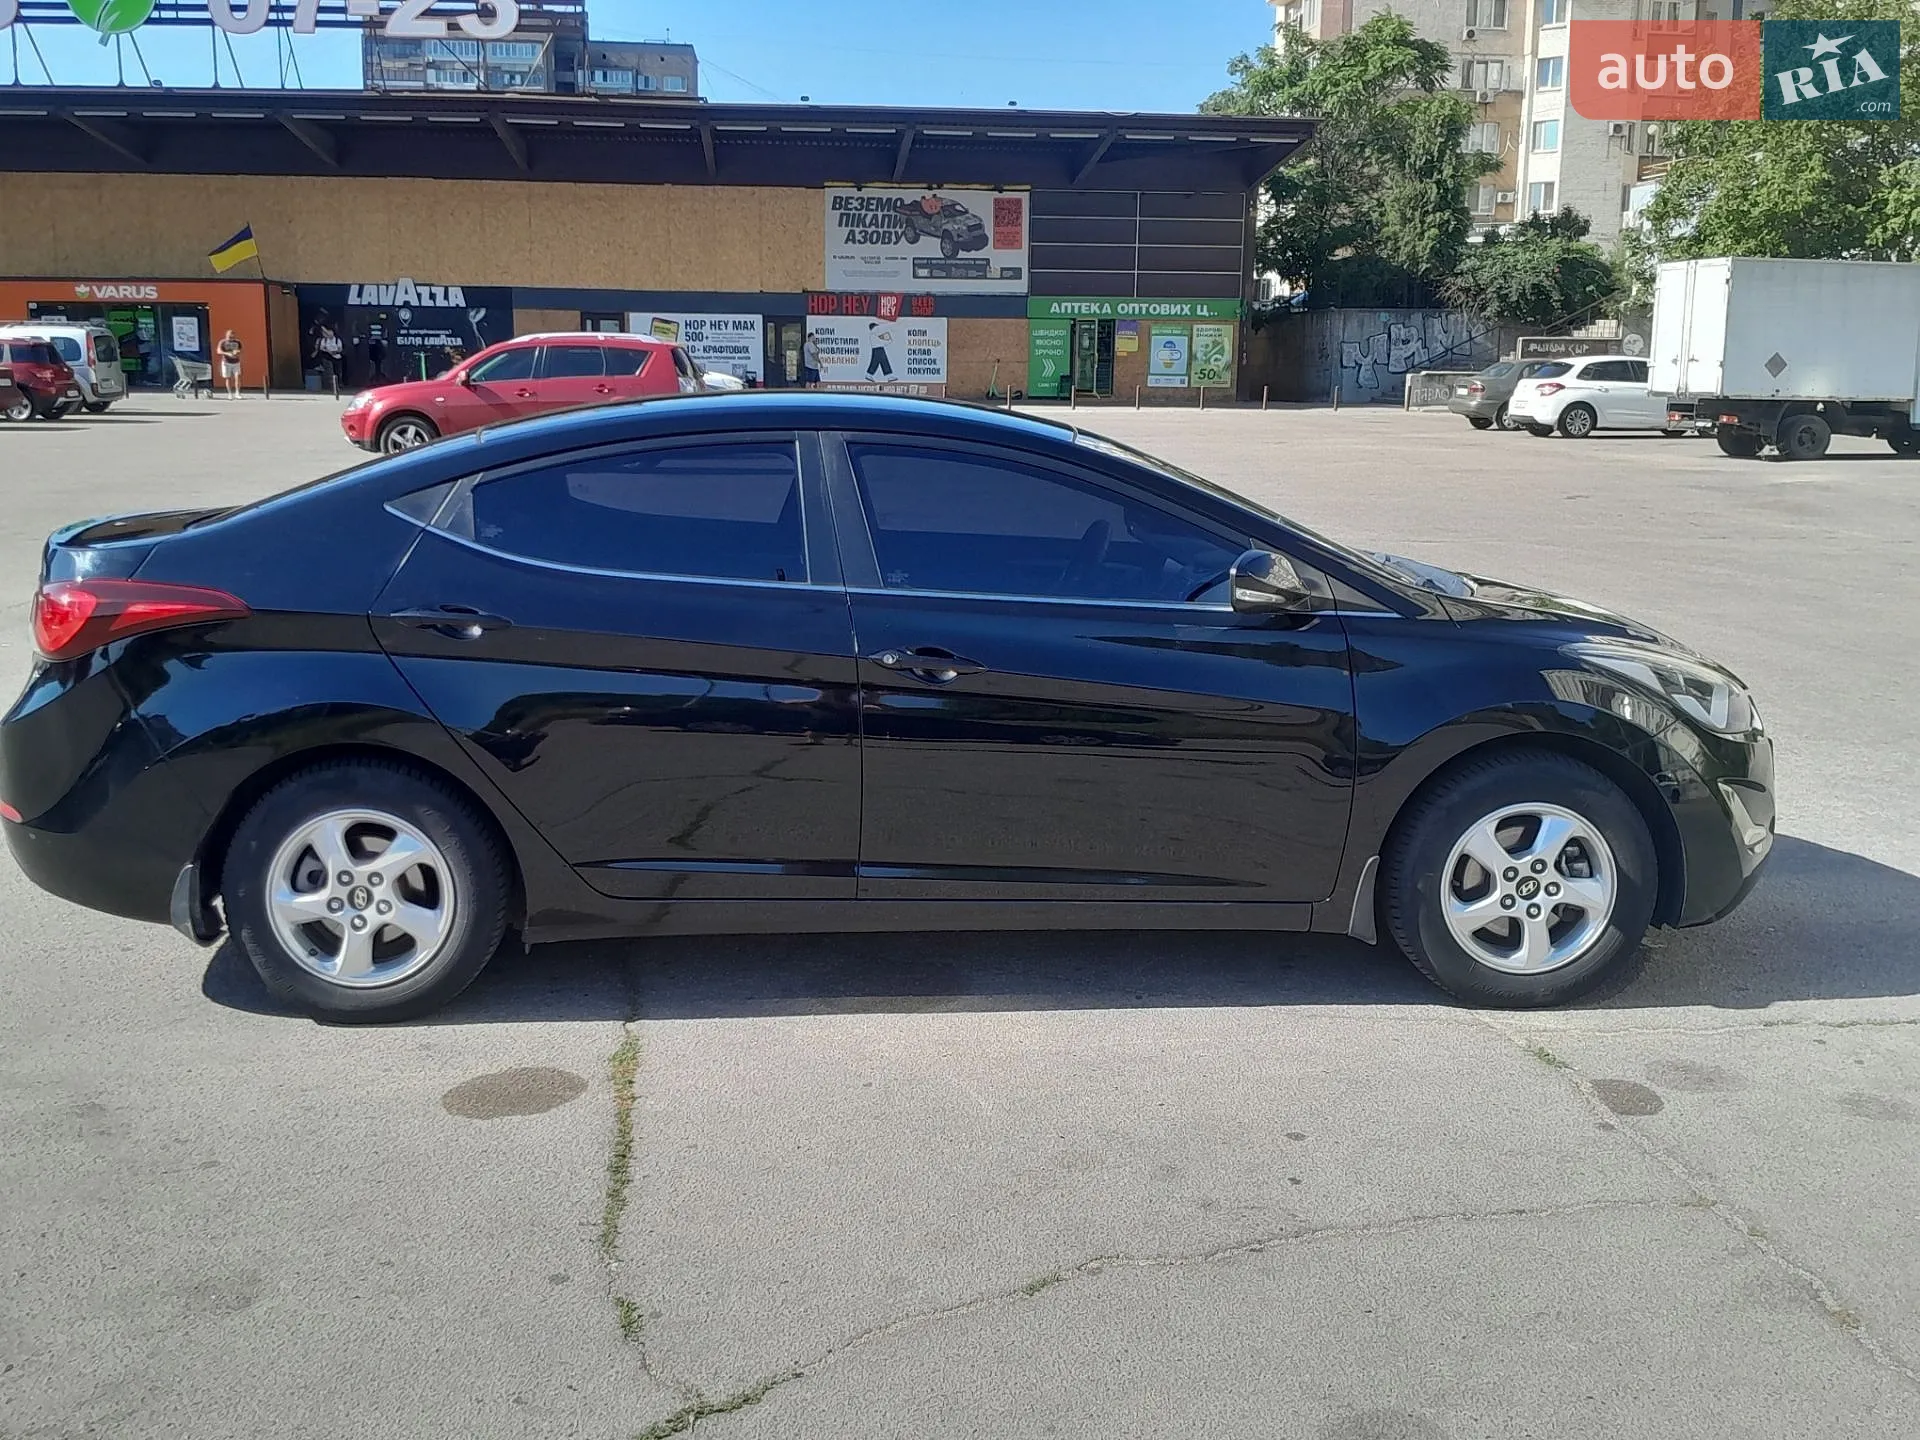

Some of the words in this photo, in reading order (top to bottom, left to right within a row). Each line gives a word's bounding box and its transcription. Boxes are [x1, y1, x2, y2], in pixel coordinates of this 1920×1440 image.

[838, 213, 904, 228] ПІКАПИ
[844, 231, 906, 245] АЗОВУ
[92, 286, 158, 299] VARUS
[348, 278, 466, 307] LAVAZZA
[808, 295, 837, 314] HOP
[842, 295, 870, 314] HEY
[880, 296, 897, 306] HOP
[880, 306, 896, 316] HEY
[1050, 303, 1111, 314] АПТЕКА
[1117, 303, 1191, 315] ОПТОВИХ
[685, 320, 706, 330] HOP
[710, 320, 729, 331] HEY
[732, 321, 756, 331] MAX
[397, 336, 422, 346] БІЛЯ
[702, 344, 751, 354] КРАФТОВИХ
[819, 347, 860, 355] НОВЛЕННЯ
[907, 358, 938, 366] СПИСОК
[907, 367, 942, 376] ПОКУПОК
